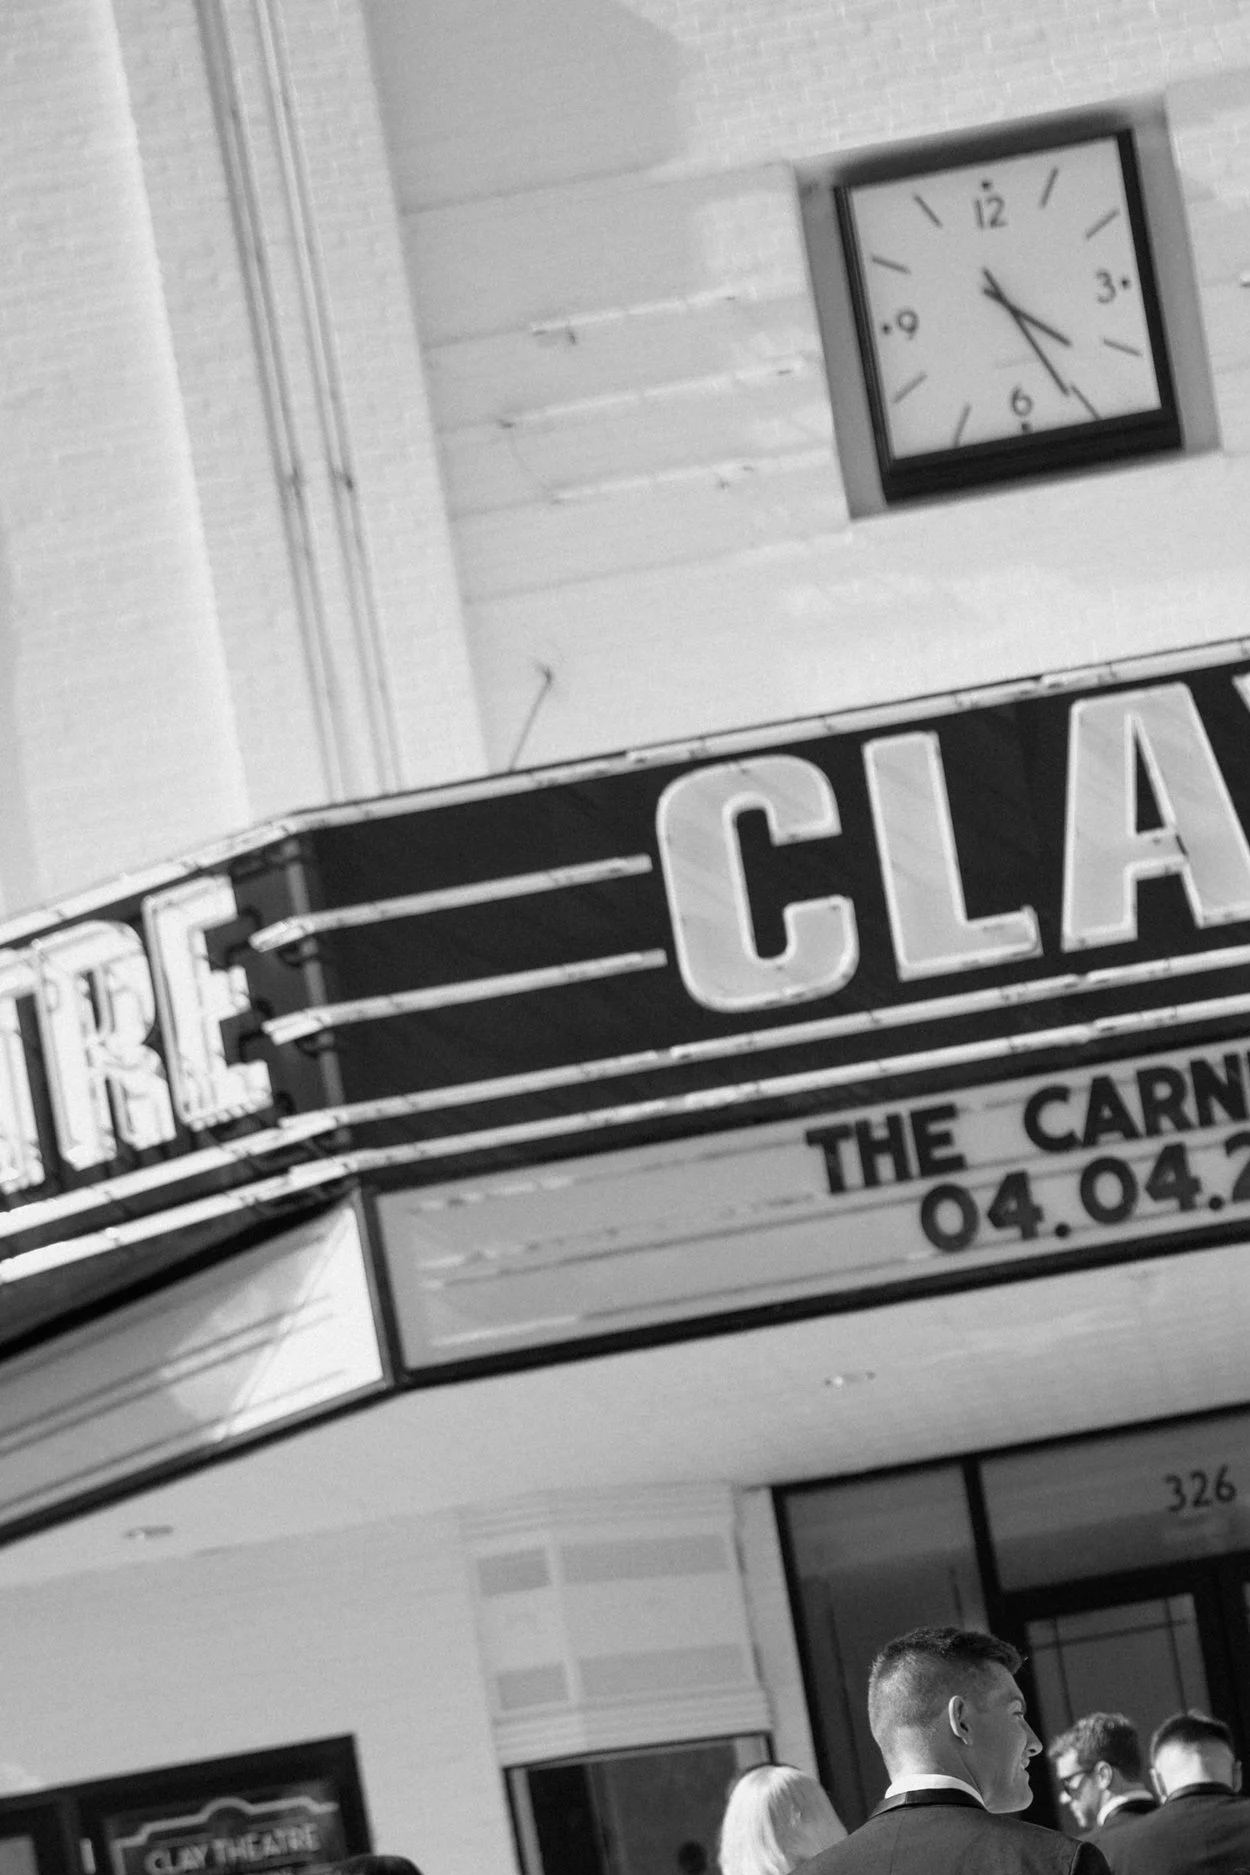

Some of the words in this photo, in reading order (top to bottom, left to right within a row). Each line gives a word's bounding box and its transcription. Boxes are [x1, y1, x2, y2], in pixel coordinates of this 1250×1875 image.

[974, 194, 1008, 230] 12
[1096, 270, 1117, 304] 3
[895, 307, 920, 340] 9
[1010, 384, 1035, 417] 6
[806, 1103, 967, 1195] THE
[1164, 1464, 1238, 1512] 326
[211, 1823, 321, 1868] THEATRE
